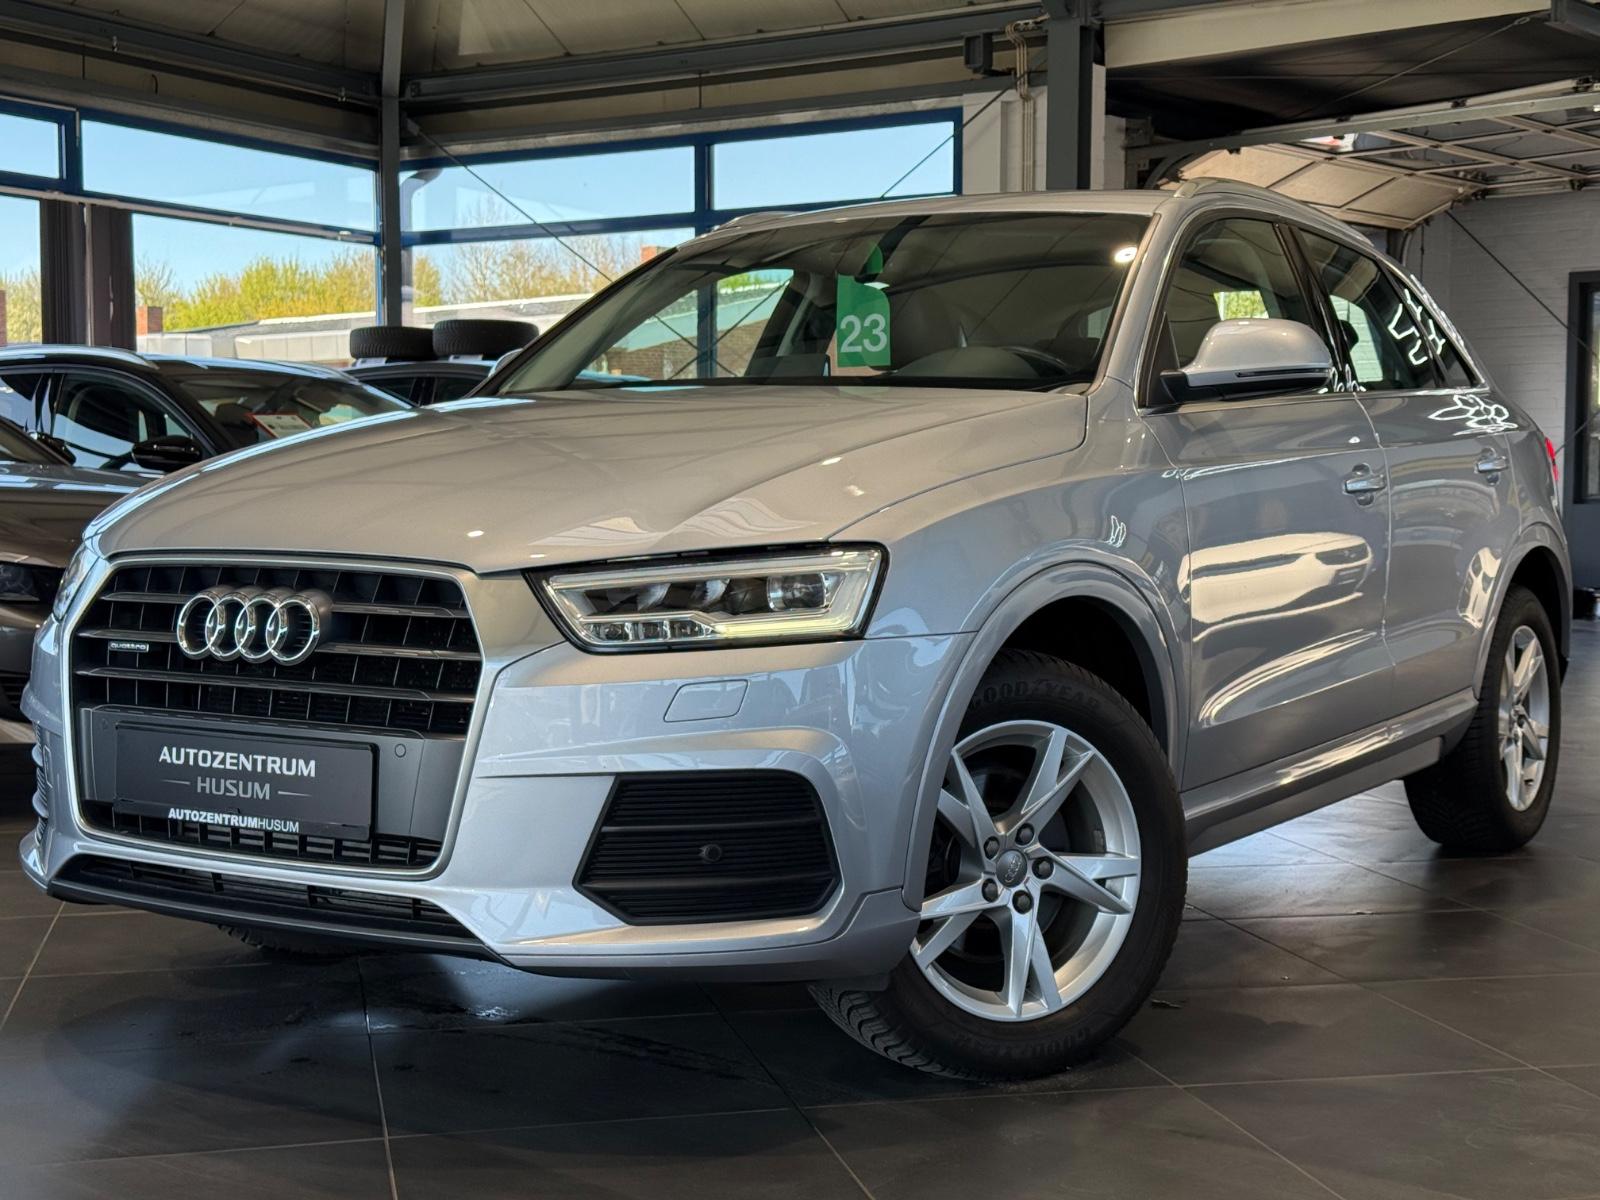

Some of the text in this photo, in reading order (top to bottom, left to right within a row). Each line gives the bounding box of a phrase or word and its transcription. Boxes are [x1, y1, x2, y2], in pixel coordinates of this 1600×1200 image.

[840, 313, 888, 352] 23
[158, 746, 316, 777] AUTOZENTRUM
[196, 776, 270, 800] HUSUM
